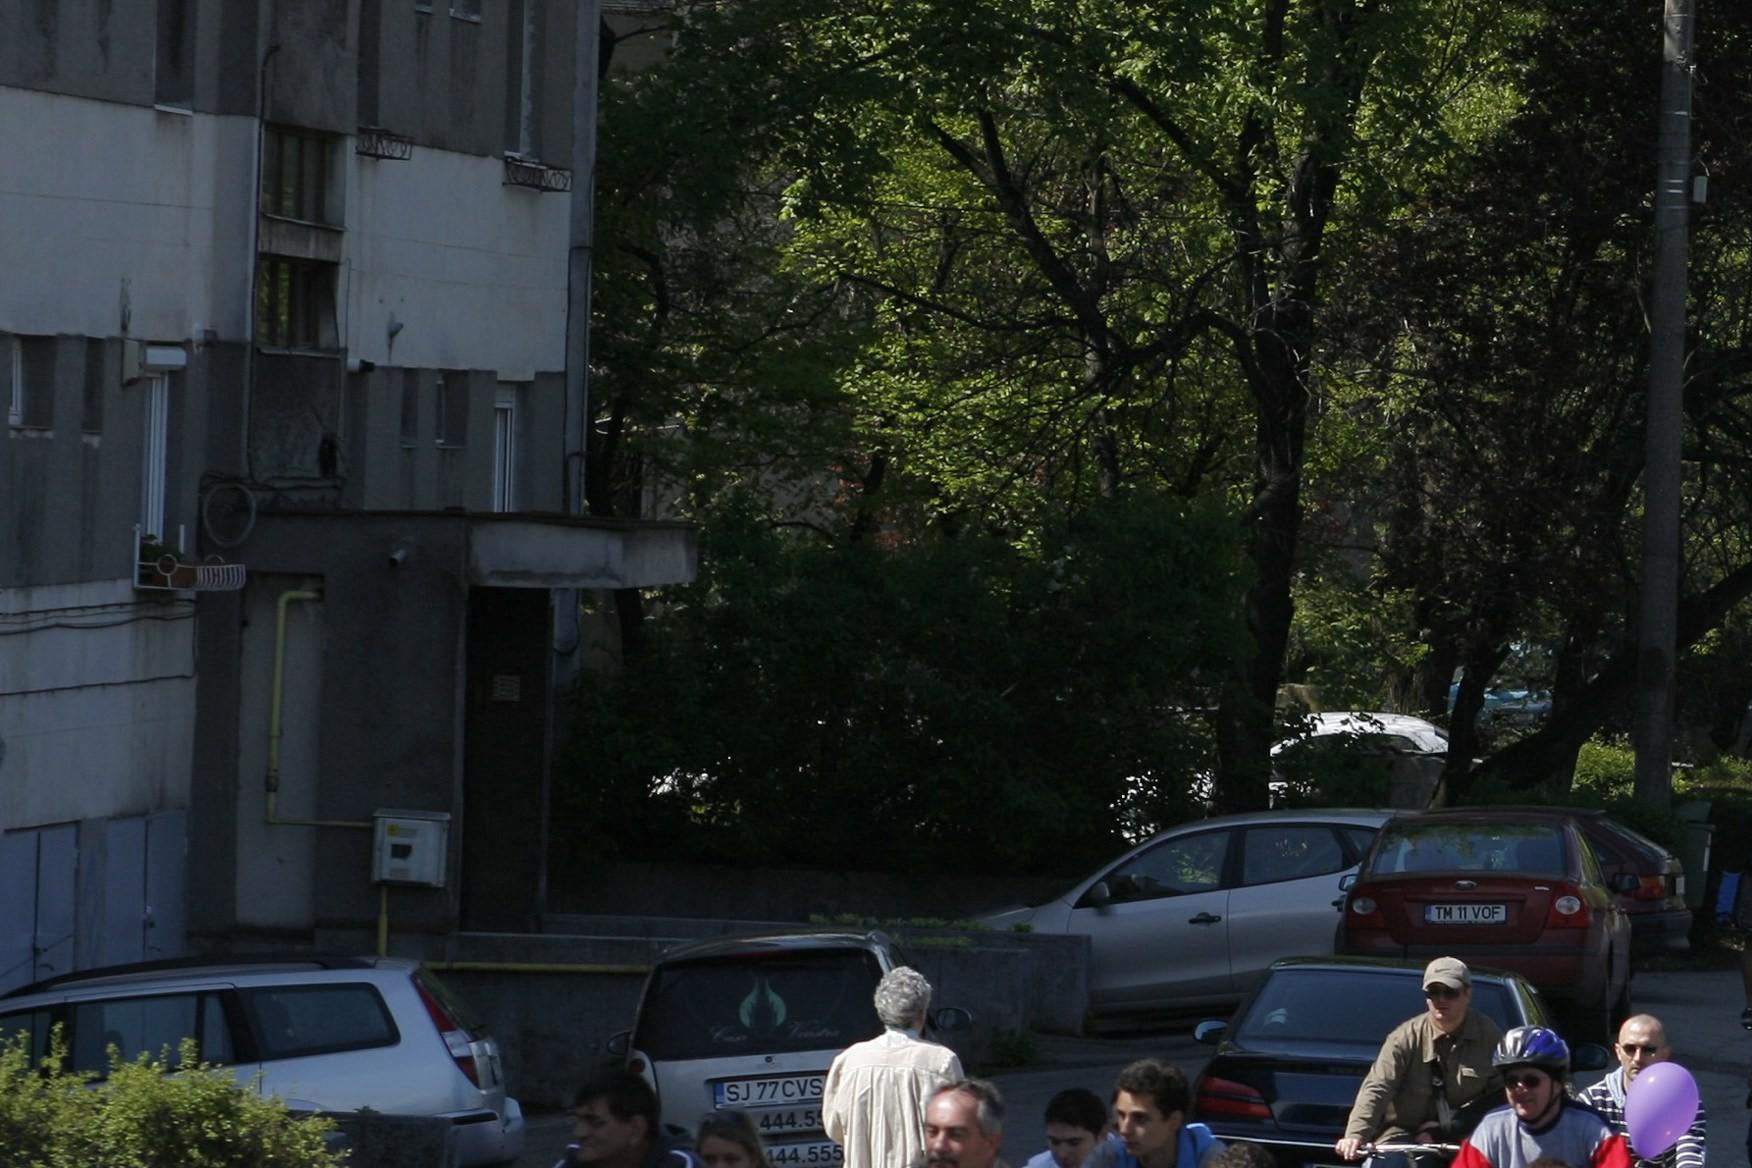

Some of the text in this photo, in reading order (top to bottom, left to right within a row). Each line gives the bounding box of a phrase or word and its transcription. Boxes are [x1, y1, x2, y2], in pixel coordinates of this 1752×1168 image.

[1435, 906, 1501, 919] TM 11 VOF
[726, 1083, 751, 1102] SJ
